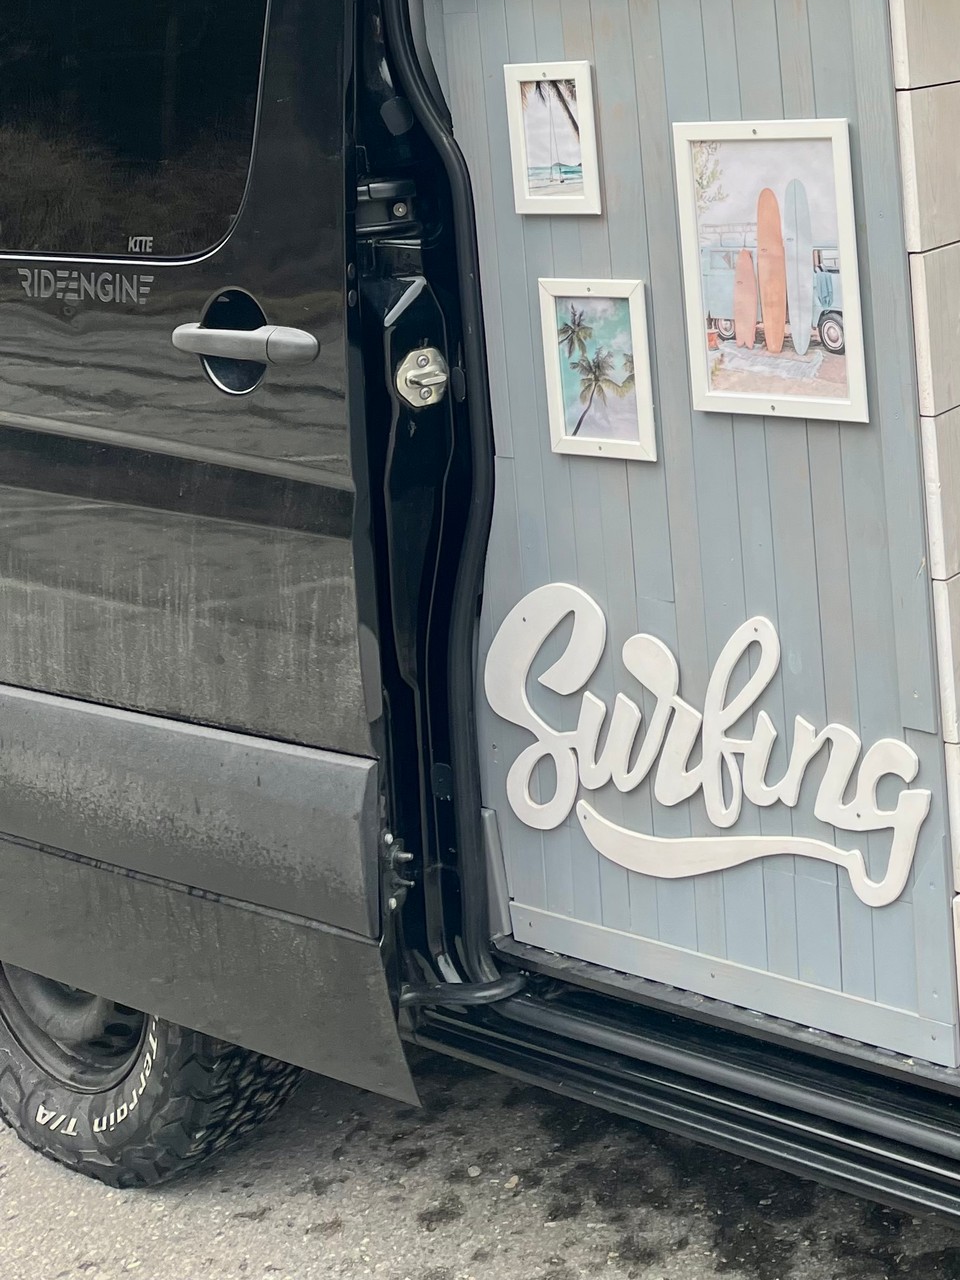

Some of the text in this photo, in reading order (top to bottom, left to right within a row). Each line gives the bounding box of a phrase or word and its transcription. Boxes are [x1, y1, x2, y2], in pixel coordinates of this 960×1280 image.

[128, 236, 154, 253] KITE
[484, 582, 931, 908] Surfing
[35, 1015, 159, 1137] -Terrain T/A
